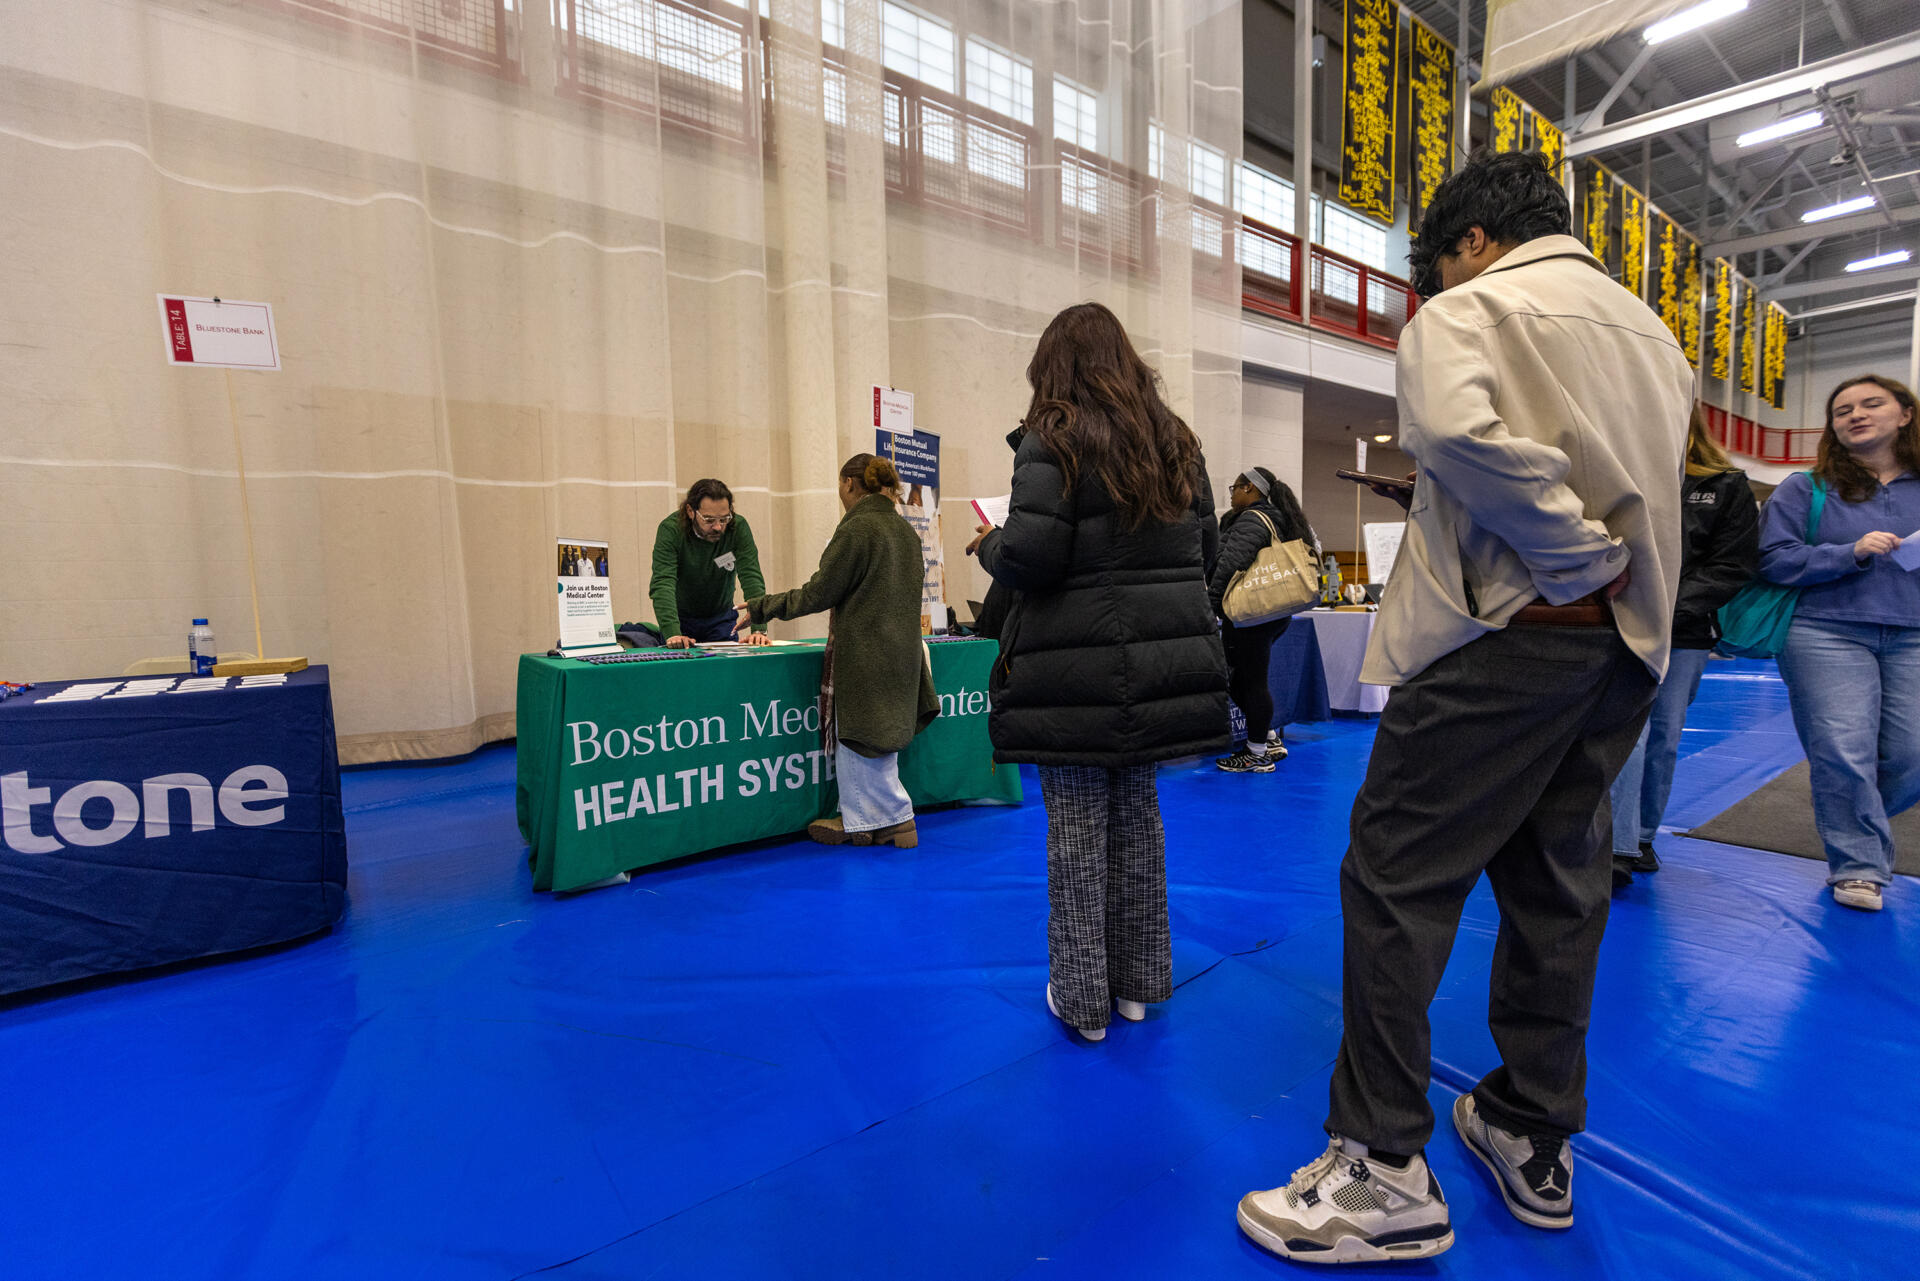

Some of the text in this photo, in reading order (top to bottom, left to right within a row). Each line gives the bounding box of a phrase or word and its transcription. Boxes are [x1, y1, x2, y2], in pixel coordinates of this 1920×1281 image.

[1416, 25, 1450, 67] NCAA
[170, 310, 182, 320] 14
[242, 327, 265, 336] BANK
[894, 434, 928, 450] Boston Mutual
[917, 450, 937, 463] Company
[1254, 563, 1278, 576] THE
[566, 714, 727, 766] Boston
[574, 764, 725, 831] HEALTH
[0, 764, 289, 854] tone
